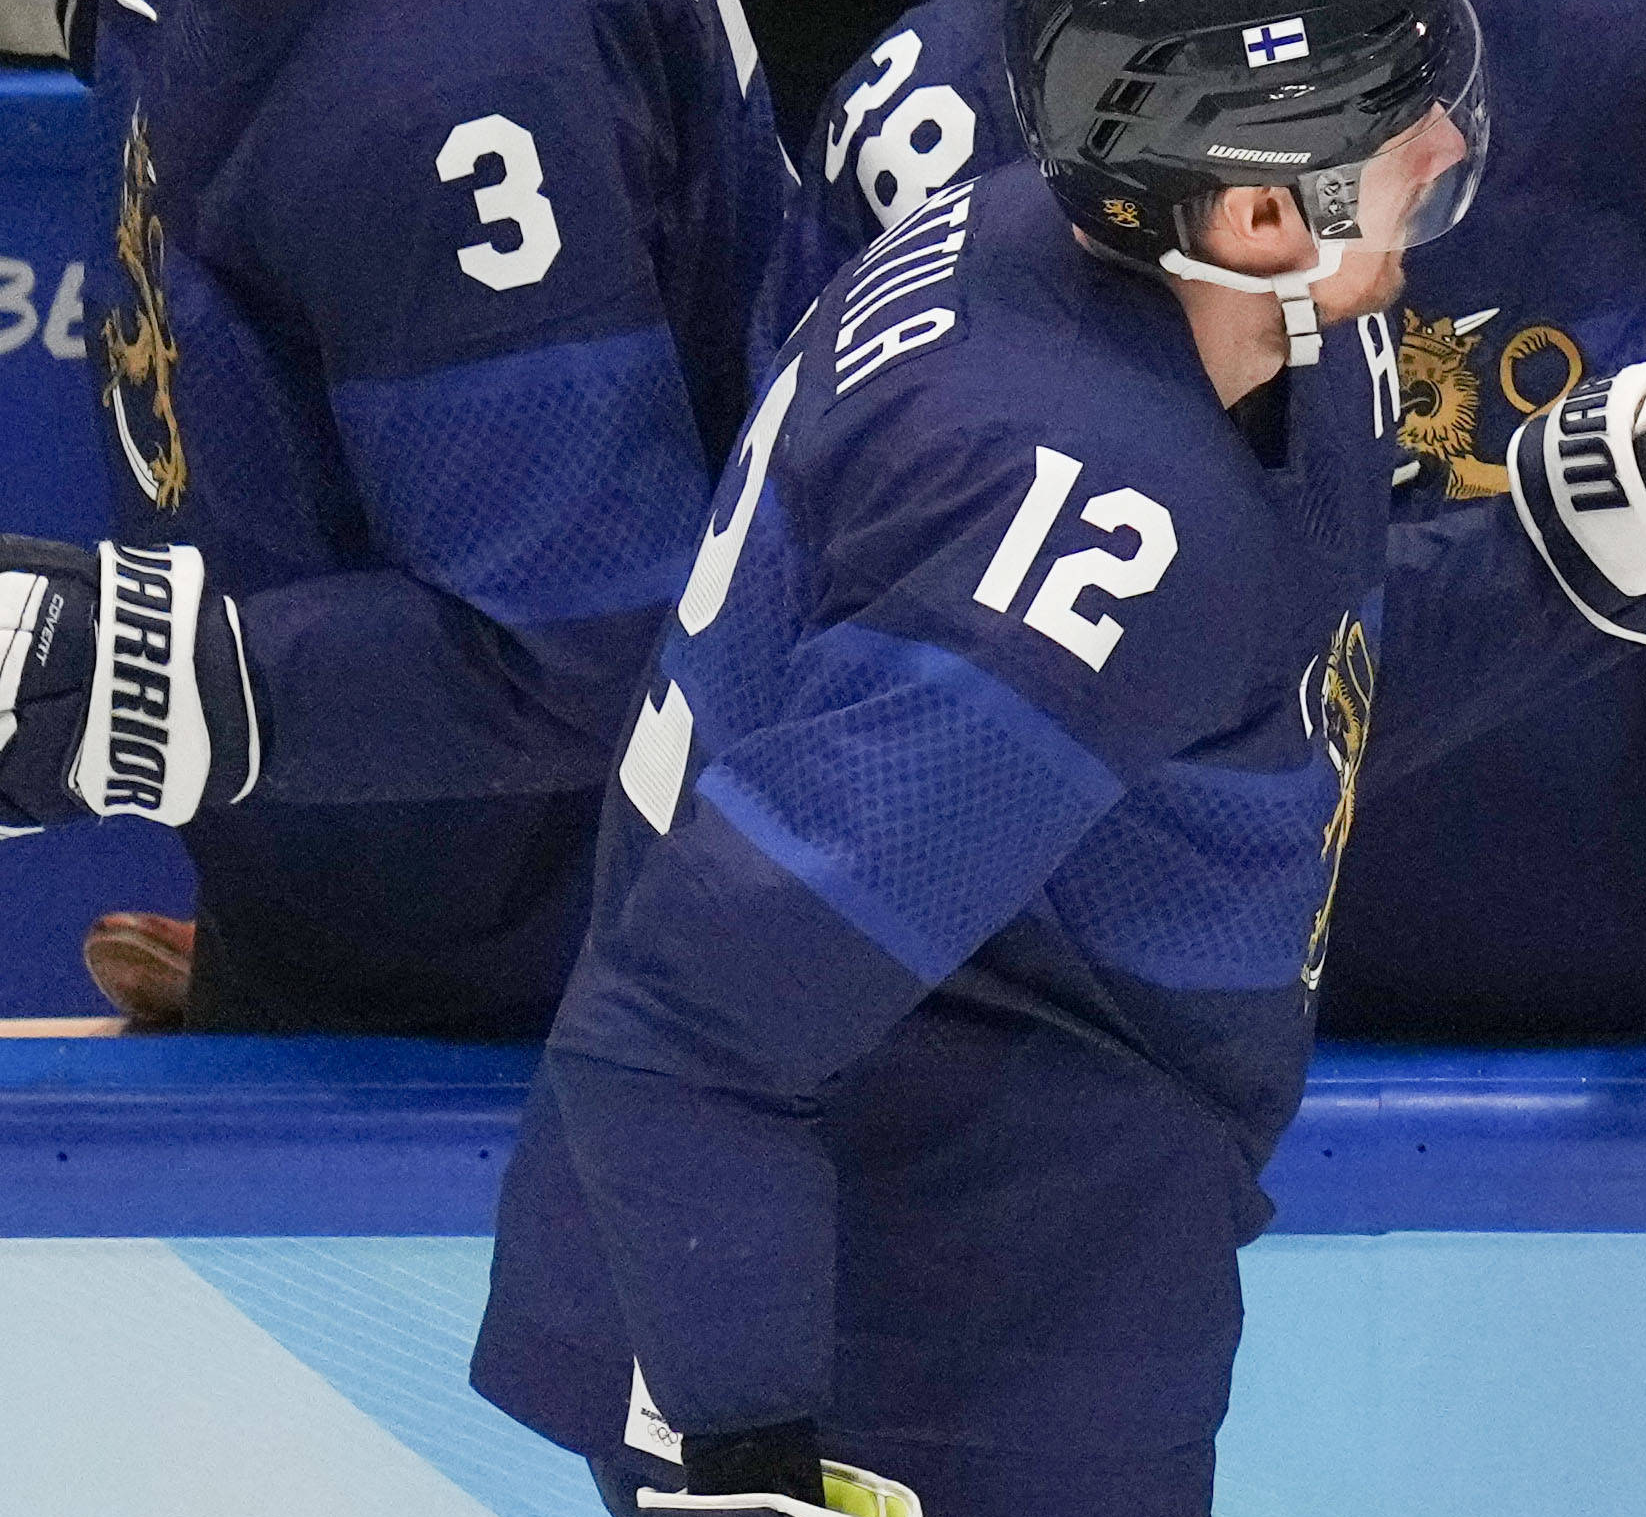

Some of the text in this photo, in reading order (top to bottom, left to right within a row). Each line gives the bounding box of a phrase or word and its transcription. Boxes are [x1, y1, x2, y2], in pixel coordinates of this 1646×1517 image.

[434, 113, 563, 291] 3
[824, 29, 976, 230] 38
[1206, 143, 1312, 167] WARRIOR
[34, 593, 64, 667] COVERT
[973, 446, 1179, 673] 12
